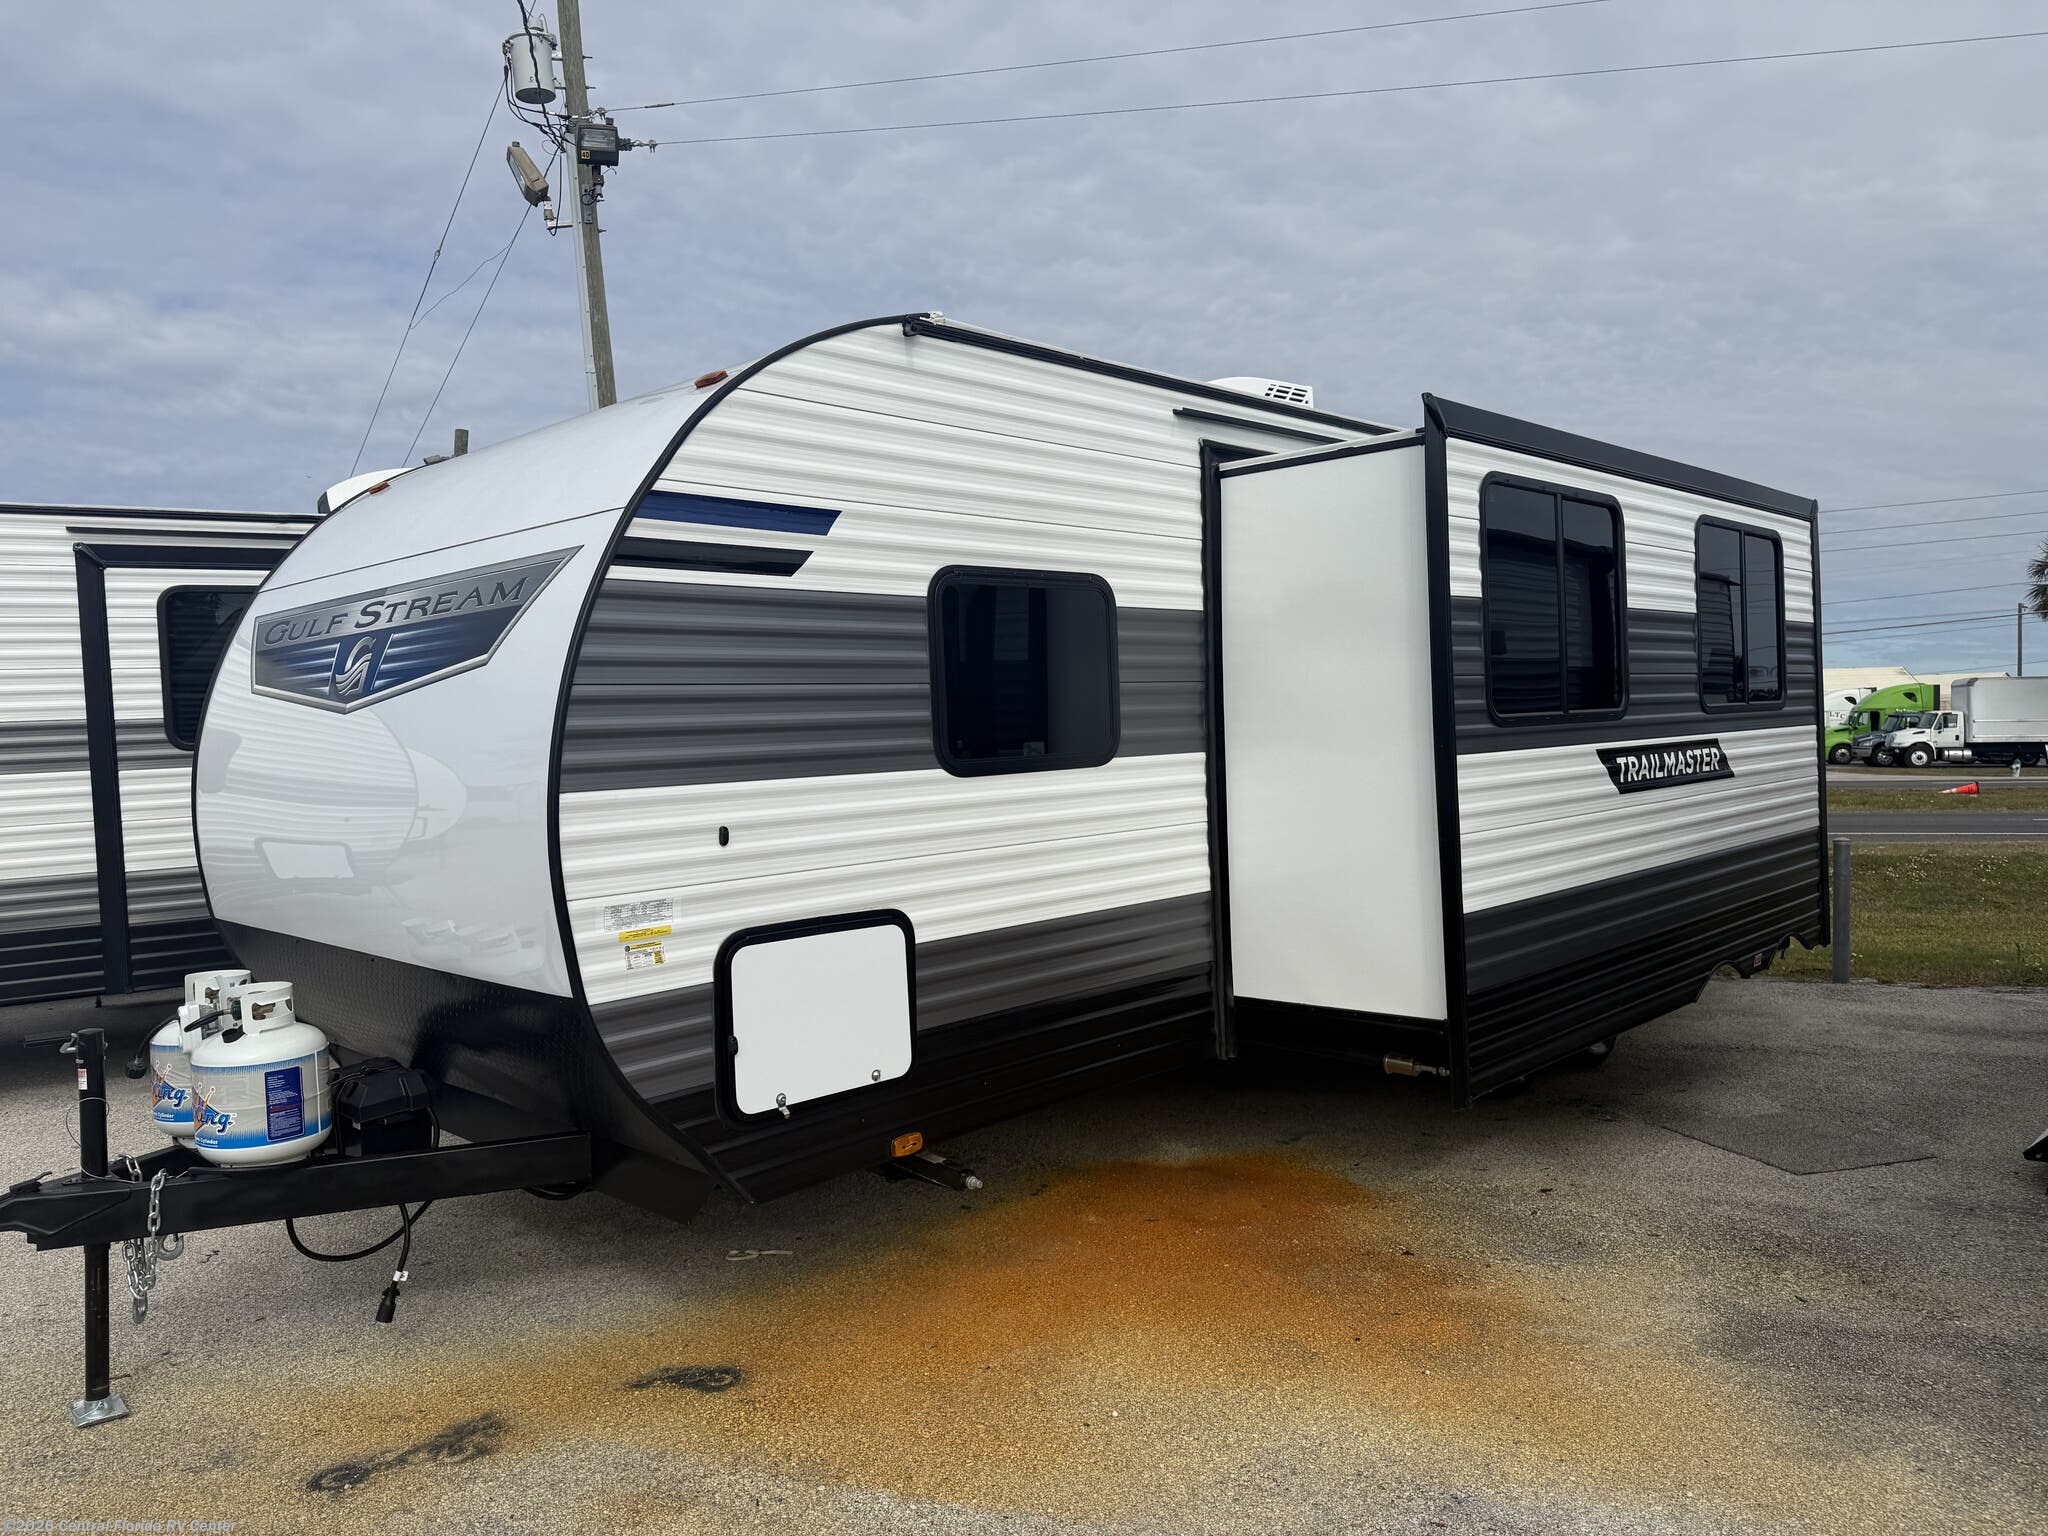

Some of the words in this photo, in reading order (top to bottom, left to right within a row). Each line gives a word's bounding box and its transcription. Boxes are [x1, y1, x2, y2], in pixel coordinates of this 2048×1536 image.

[264, 612, 348, 646] GULF
[354, 576, 528, 629] STREAM
[1616, 747, 1720, 783] TRAILMASTER
